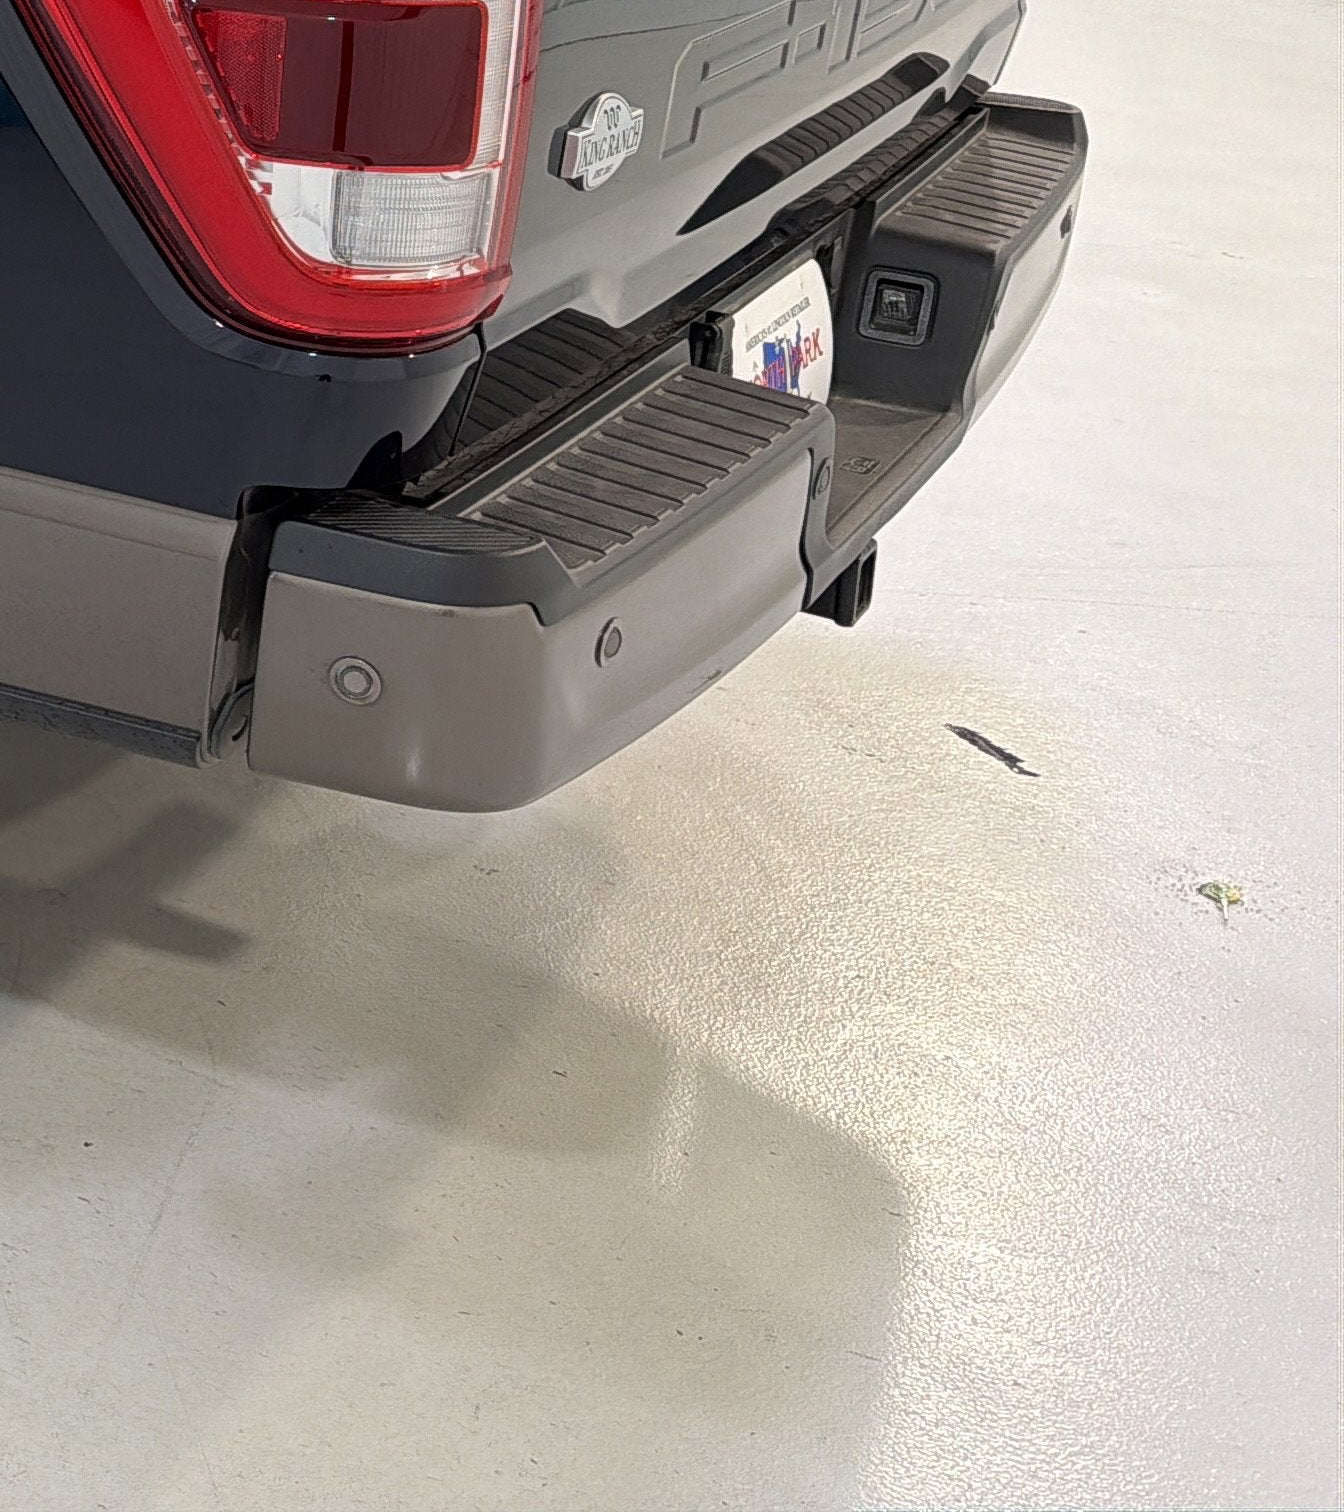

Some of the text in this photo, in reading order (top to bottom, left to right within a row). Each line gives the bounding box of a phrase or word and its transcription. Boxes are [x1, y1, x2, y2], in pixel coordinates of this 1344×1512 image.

[579, 120, 641, 169] KING RANCH
[790, 327, 824, 377] PARK
